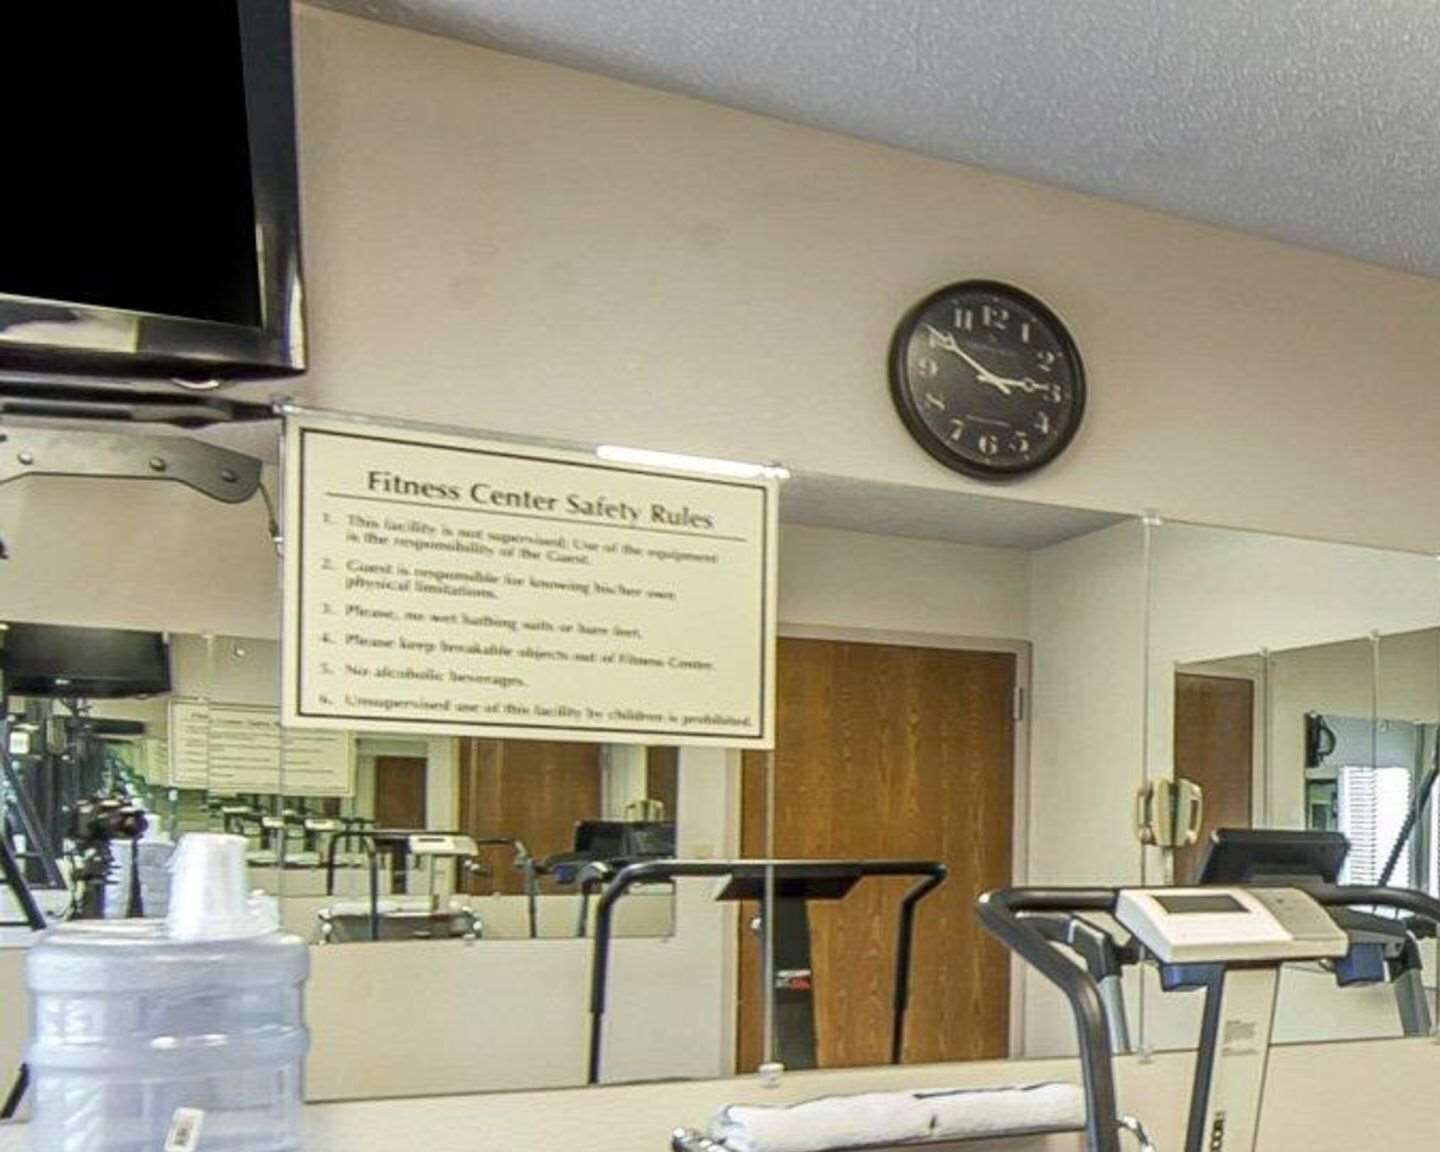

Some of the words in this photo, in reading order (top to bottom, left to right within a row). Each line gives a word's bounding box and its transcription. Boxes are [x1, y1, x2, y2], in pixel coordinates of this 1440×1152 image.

[953, 307, 974, 331] 11
[981, 305, 1011, 331] 12
[1020, 322, 1031, 344] 1
[917, 358, 939, 377] 9
[1036, 350, 1056, 373] 2
[949, 417, 964, 442] 7
[1033, 410, 1050, 435] 4
[977, 433, 1000, 456] 6
[1008, 429, 1030, 453] 5
[367, 469, 461, 500] Fitness
[470, 482, 558, 511] Center
[566, 493, 642, 521] Safety
[650, 503, 716, 529] Rules
[345, 532, 359, 544] is
[363, 533, 390, 545] the
[393, 537, 494, 557] responsibility
[500, 546, 515, 558] of
[520, 548, 541, 560] the
[347, 513, 380, 529] This
[384, 518, 437, 536] facility
[441, 525, 454, 537] is
[458, 527, 483, 540] not
[602, 542, 621, 553] of
[622, 544, 643, 556] the
[647, 549, 718, 565] equipment
[345, 559, 393, 576] Guest
[396, 564, 410, 577] is
[414, 567, 499, 585] responsible
[503, 574, 525, 587] for
[528, 576, 591, 596] knowing
[645, 590, 677, 601] own
[345, 577, 411, 593] physical
[413, 581, 499, 599] limitations.
[404, 611, 425, 621] no
[429, 612, 458, 624] wet
[461, 614, 519, 632] bathing
[523, 619, 555, 633] suits
[558, 623, 574, 633] or
[576, 622, 609, 636] bare
[345, 633, 396, 649] Please
[399, 637, 437, 654] keep
[439, 641, 513, 658] breakable
[517, 648, 570, 663] objects
[574, 651, 597, 663] out
[601, 653, 617, 664] of
[618, 653, 665, 668] Fitness
[345, 664, 370, 677] No
[373, 666, 445, 682] alcoholic
[448, 670, 529, 688] beverages.
[345, 694, 451, 714] Unsupervised
[455, 701, 480, 714] use
[483, 702, 501, 714] of
[503, 703, 530, 717] this
[533, 705, 582, 721] facility
[586, 707, 605, 722] by
[607, 709, 664, 725] children
[668, 713, 679, 725] is
[682, 714, 753, 730] prohibited.
